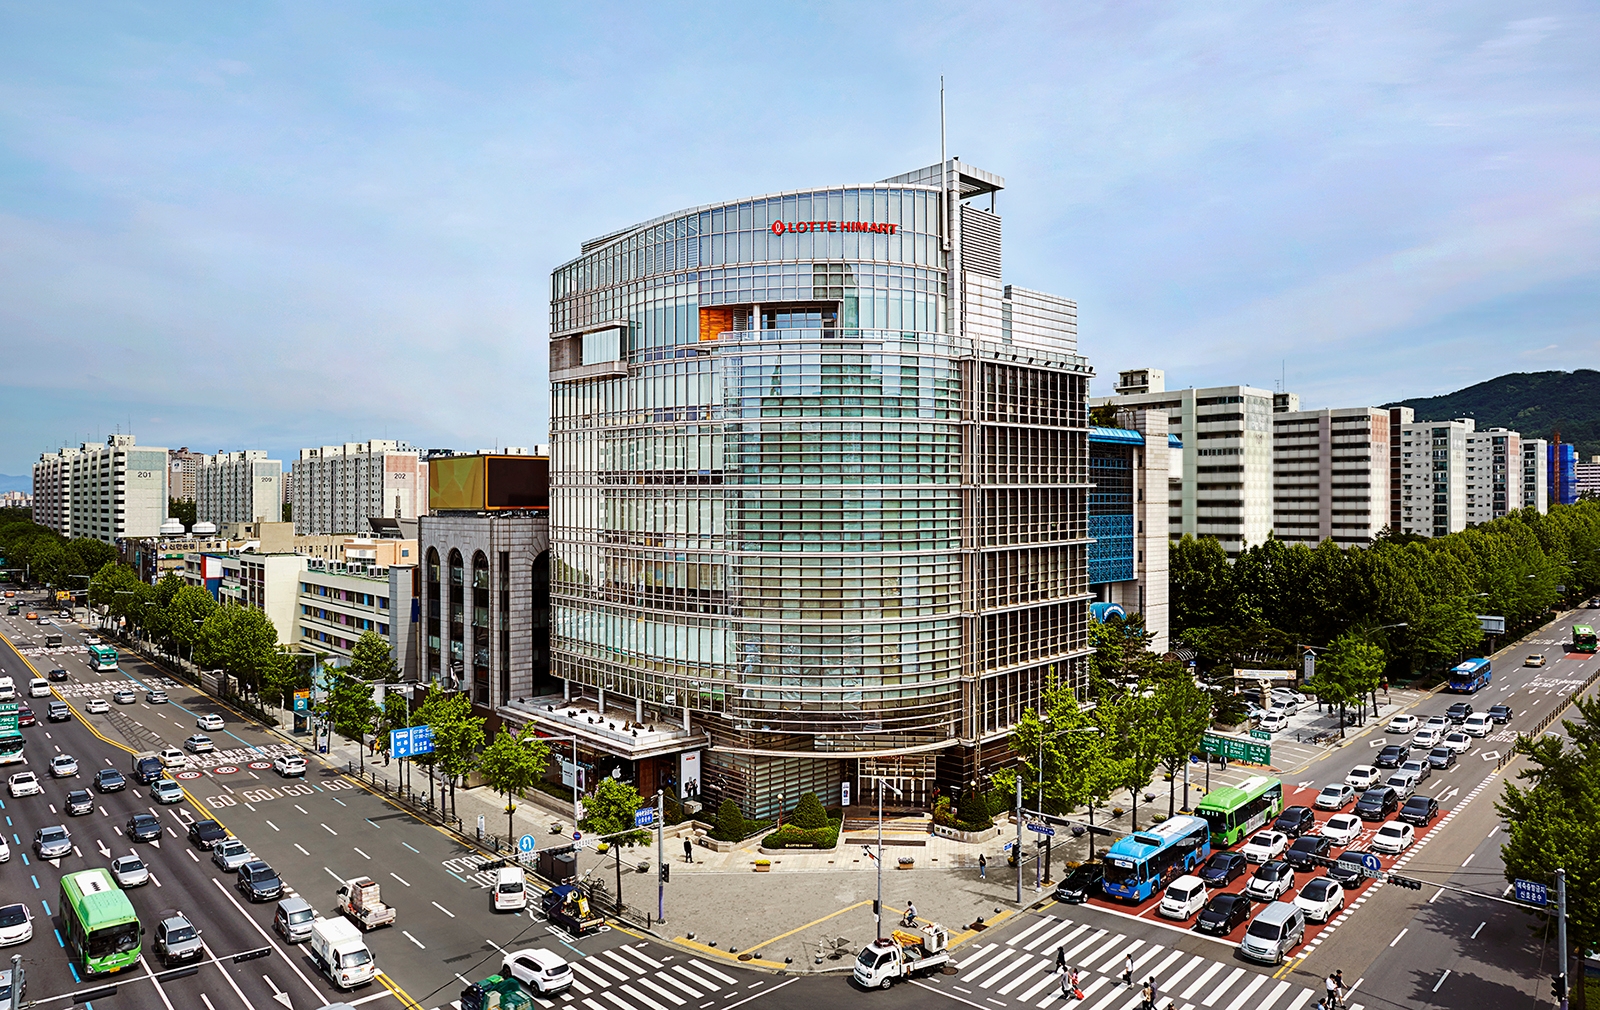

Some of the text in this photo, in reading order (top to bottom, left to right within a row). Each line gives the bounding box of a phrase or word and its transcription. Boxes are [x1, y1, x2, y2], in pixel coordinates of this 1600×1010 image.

[788, 221, 899, 235] LOTTE HIMART
[281, 784, 315, 797] 60
[320, 779, 354, 792] 60
[206, 794, 238, 809] 60
[242, 789, 275, 803] 60
[1516, 881, 1546, 894] 예측출발금지
[1520, 890, 1542, 902] 신호준수
